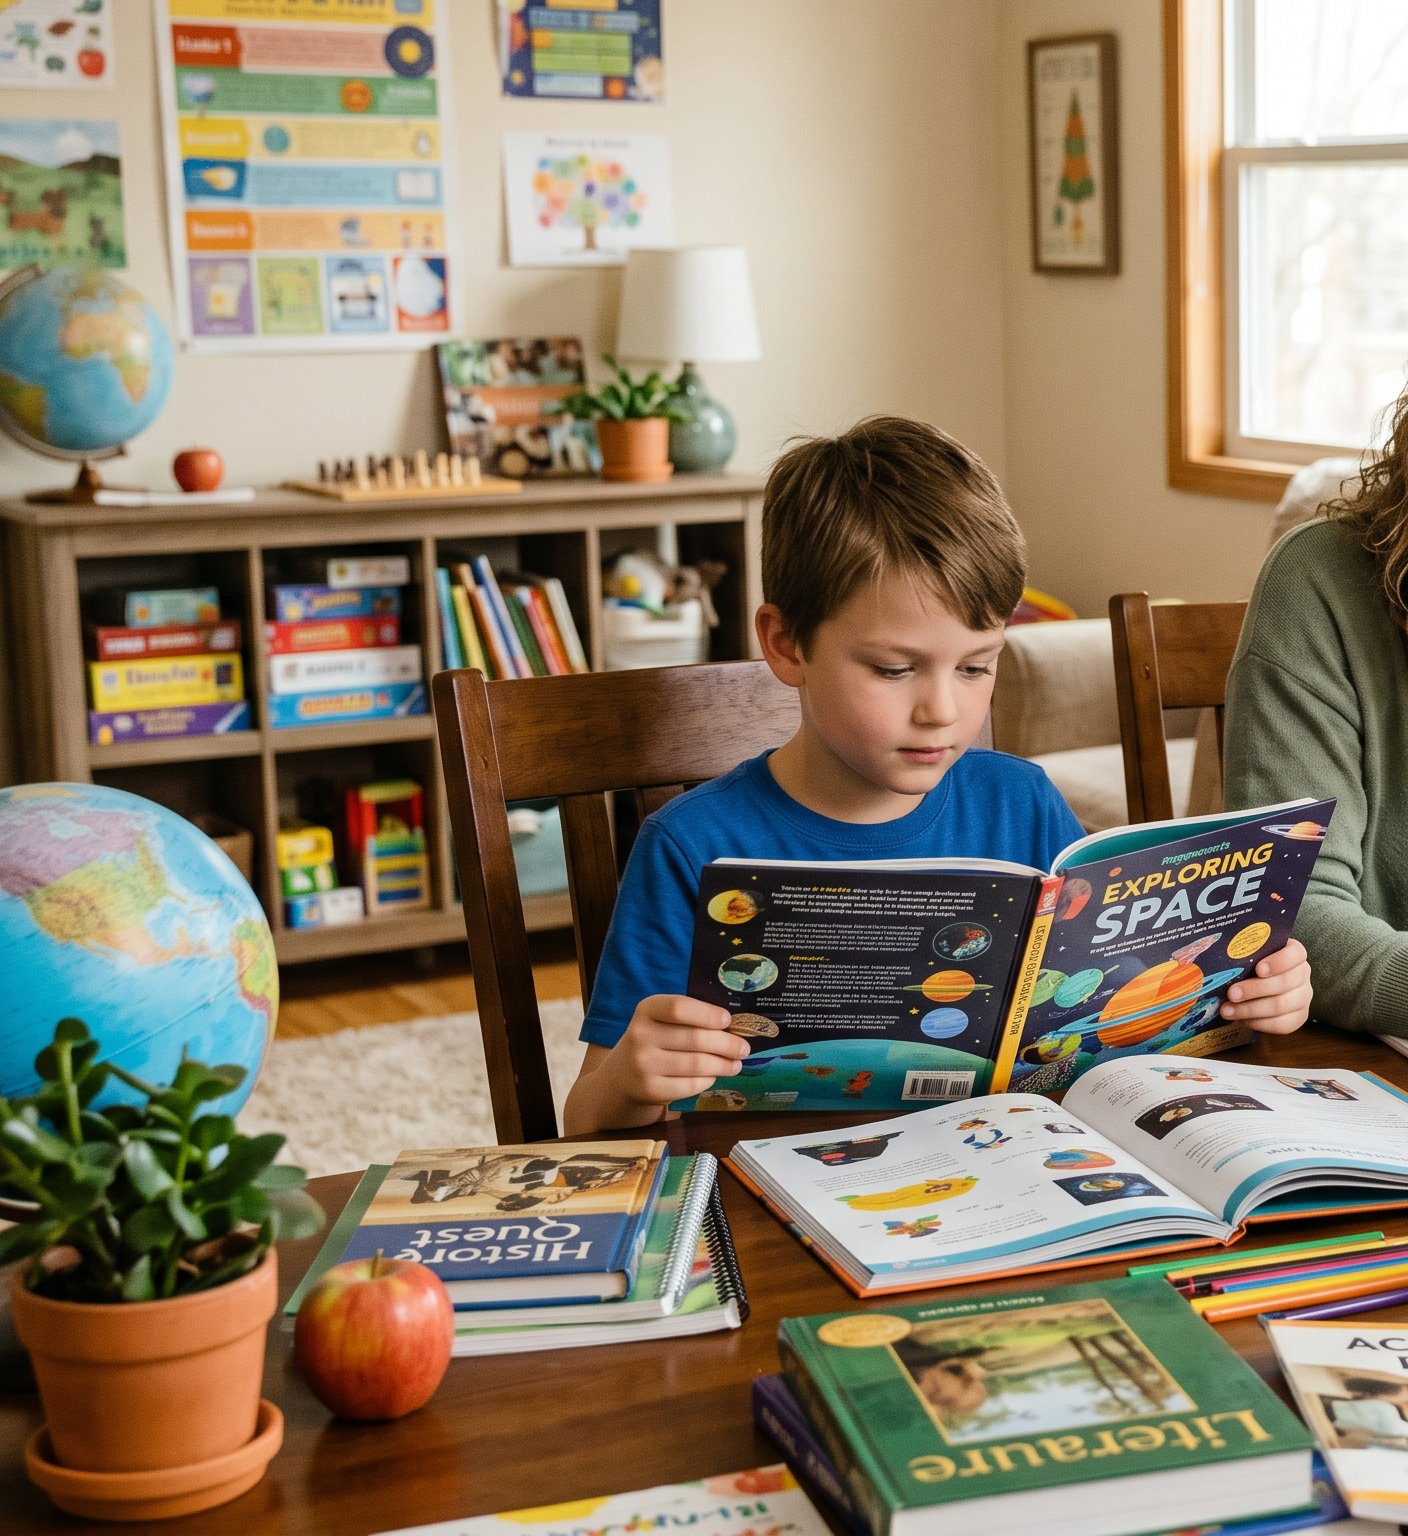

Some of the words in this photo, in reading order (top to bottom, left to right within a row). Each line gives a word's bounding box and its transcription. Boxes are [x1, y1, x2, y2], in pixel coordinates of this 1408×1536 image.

[1091, 866, 1267, 944] SPACE
[1102, 842, 1274, 905] EXPLORING
[410, 1215, 581, 1248] Quest
[907, 1408, 1274, 1483] Literaure
